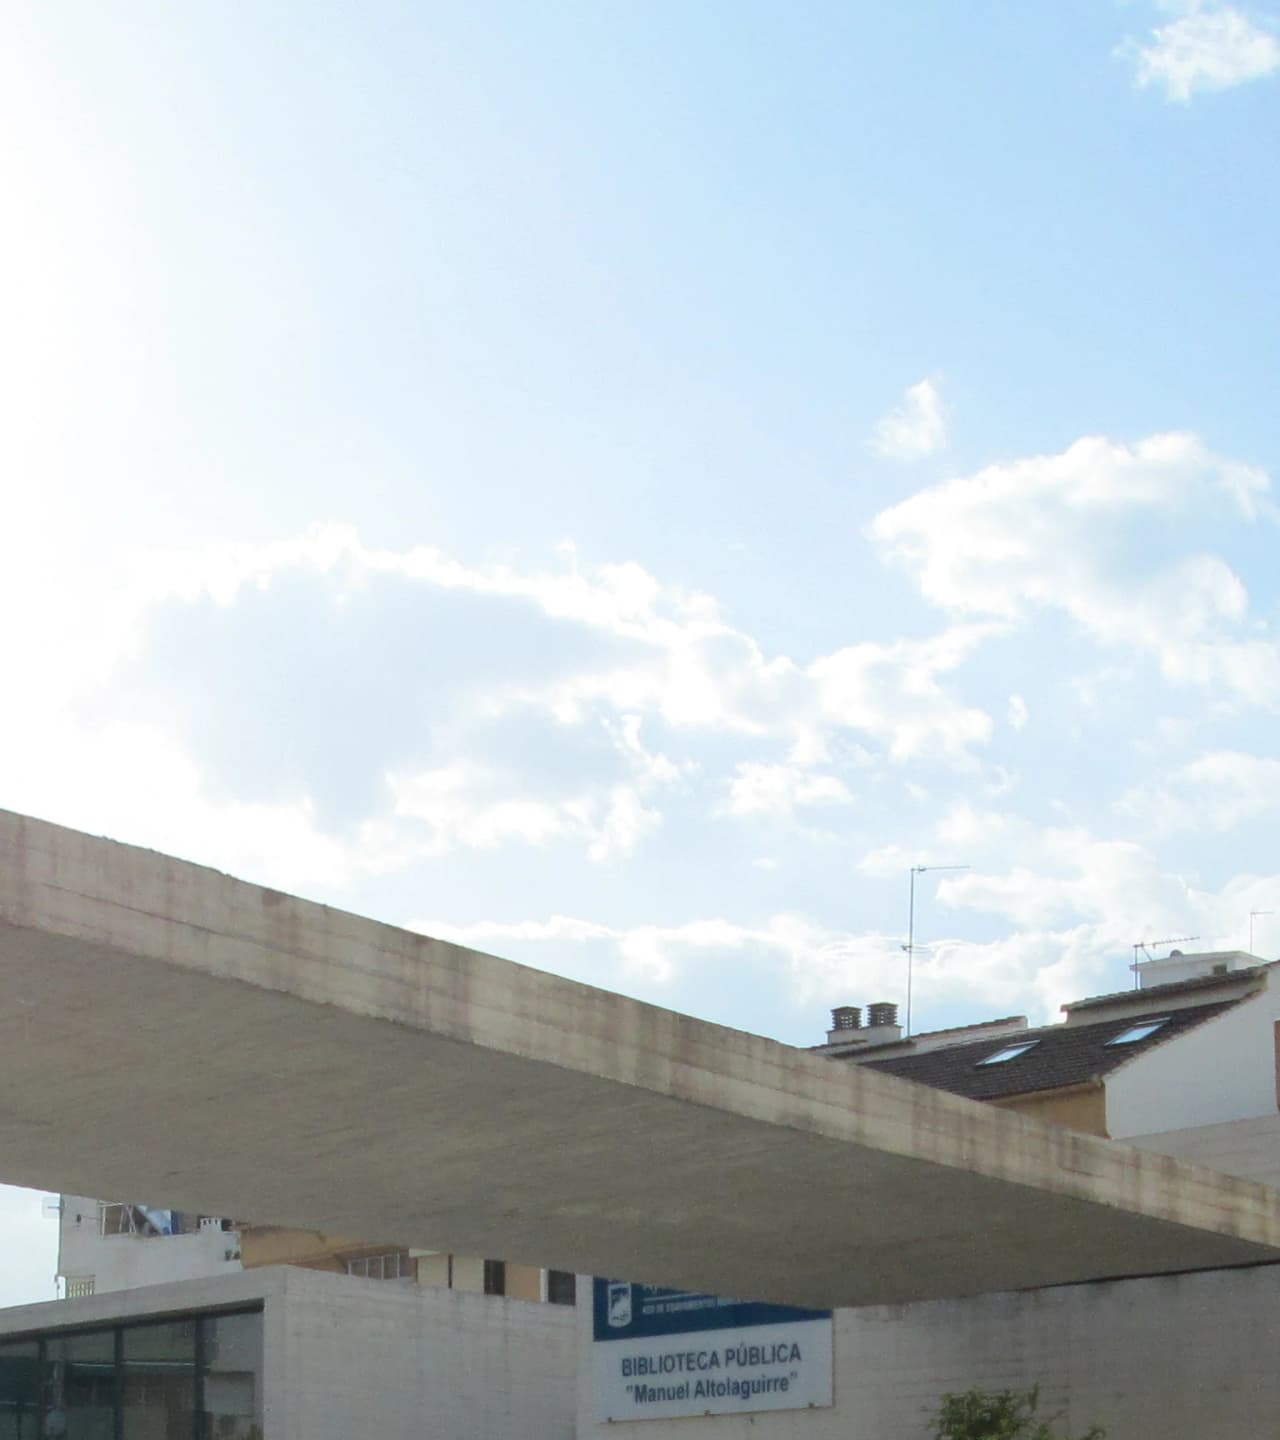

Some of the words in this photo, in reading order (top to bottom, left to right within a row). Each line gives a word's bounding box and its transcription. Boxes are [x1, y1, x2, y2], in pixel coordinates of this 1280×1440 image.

[622, 1350, 720, 1377] BIBLIOTECA
[725, 1343, 801, 1368] PÚBLICA
[626, 1380, 689, 1404] "Manuel
[695, 1372, 798, 1400] Altolaguirre"
